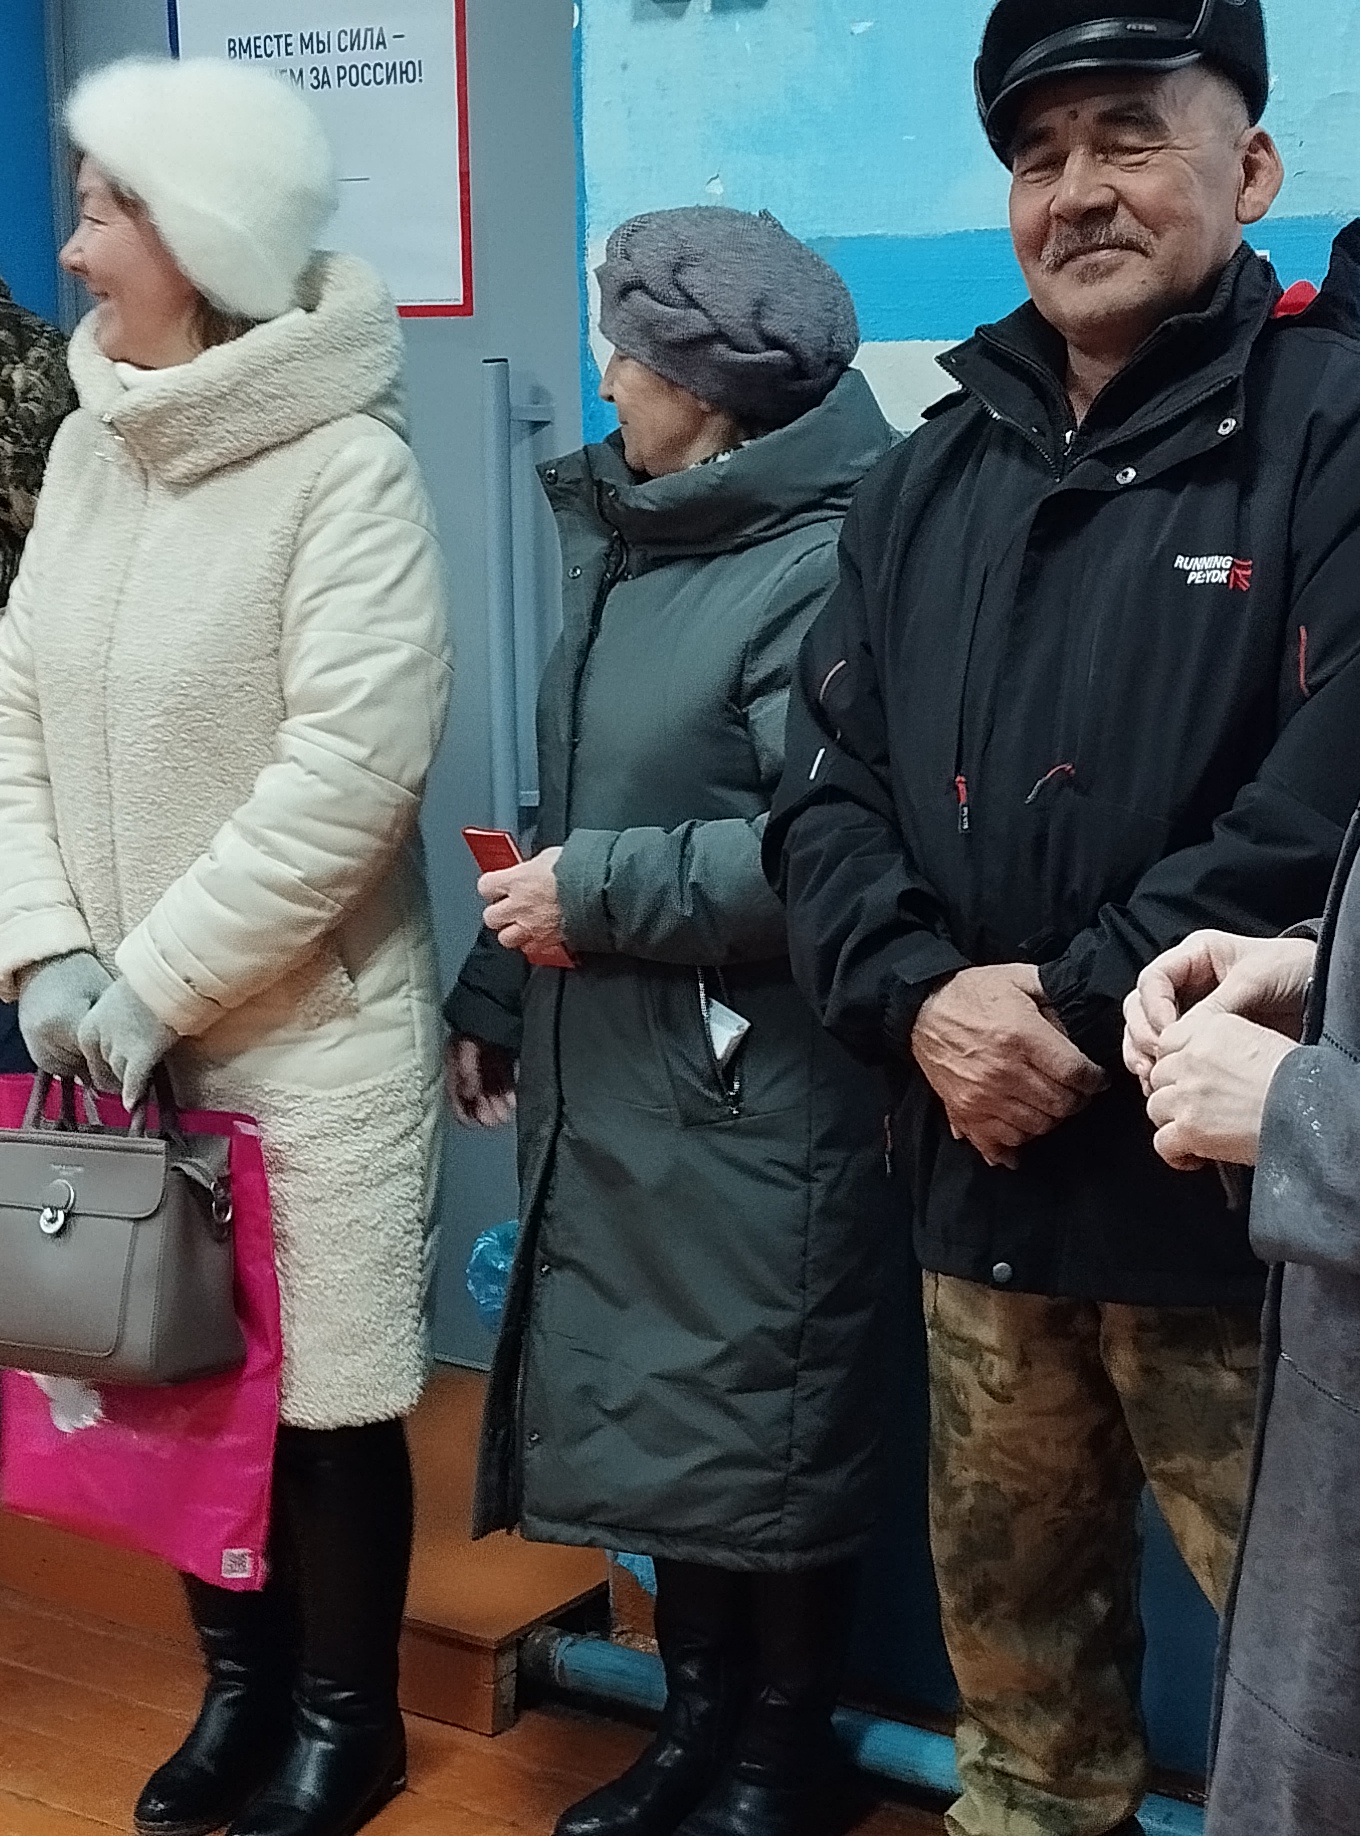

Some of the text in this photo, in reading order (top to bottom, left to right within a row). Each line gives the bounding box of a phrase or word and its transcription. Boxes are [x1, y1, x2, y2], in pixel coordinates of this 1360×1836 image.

[227, 33, 294, 60] ВМЕСТЕ
[299, 30, 332, 56] МЫ
[337, 26, 388, 53] СИЛА
[309, 65, 332, 90] ЗА
[336, 59, 424, 88] РОССИЮ!
[1173, 554, 1234, 571] RUNNING
